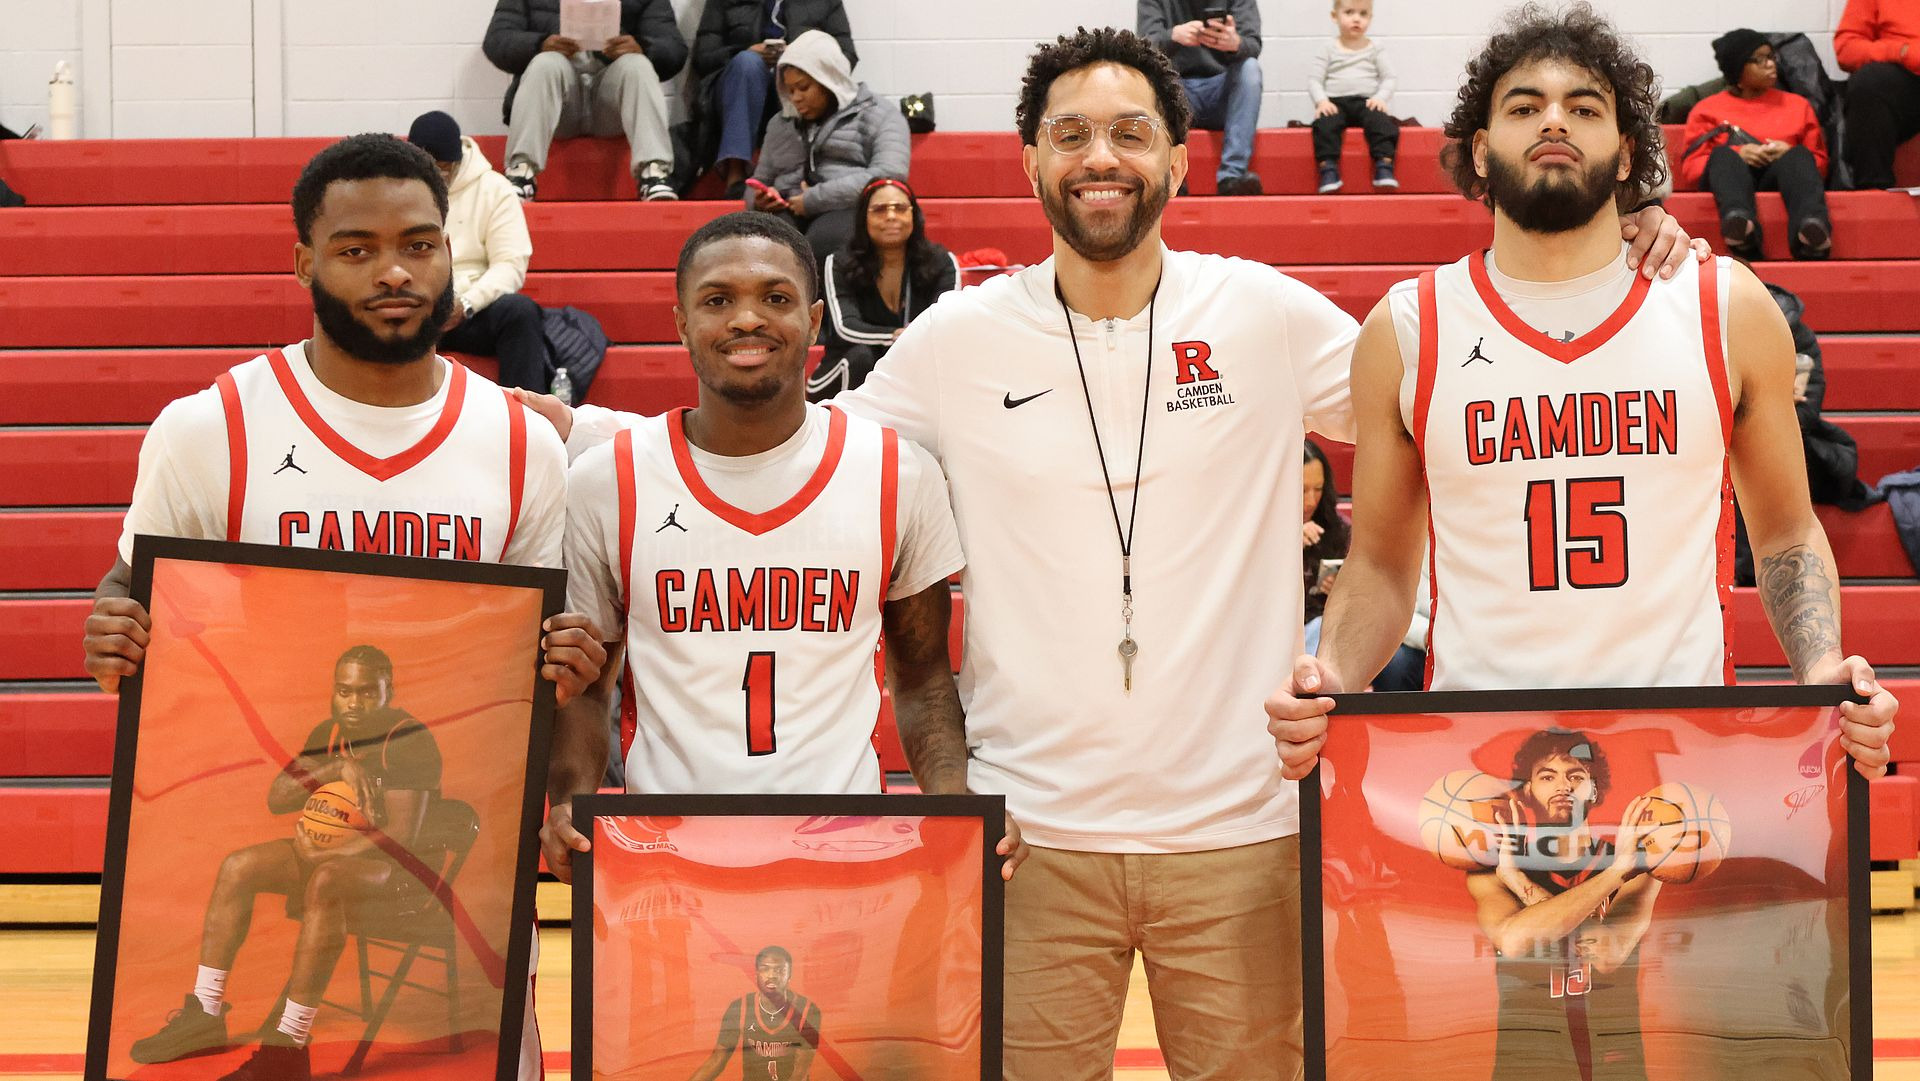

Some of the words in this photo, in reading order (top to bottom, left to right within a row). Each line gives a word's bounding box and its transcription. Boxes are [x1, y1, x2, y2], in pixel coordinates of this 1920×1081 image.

[1172, 341, 1219, 385] R
[1177, 383, 1223, 398] CAMDEN
[1166, 394, 1235, 412] BASKETBALL
[1465, 390, 1678, 465] CAMDEN
[279, 511, 482, 561] CAMDEN
[1524, 476, 1629, 591] 15
[655, 567, 860, 632] CAMDEN
[742, 651, 777, 756] 1
